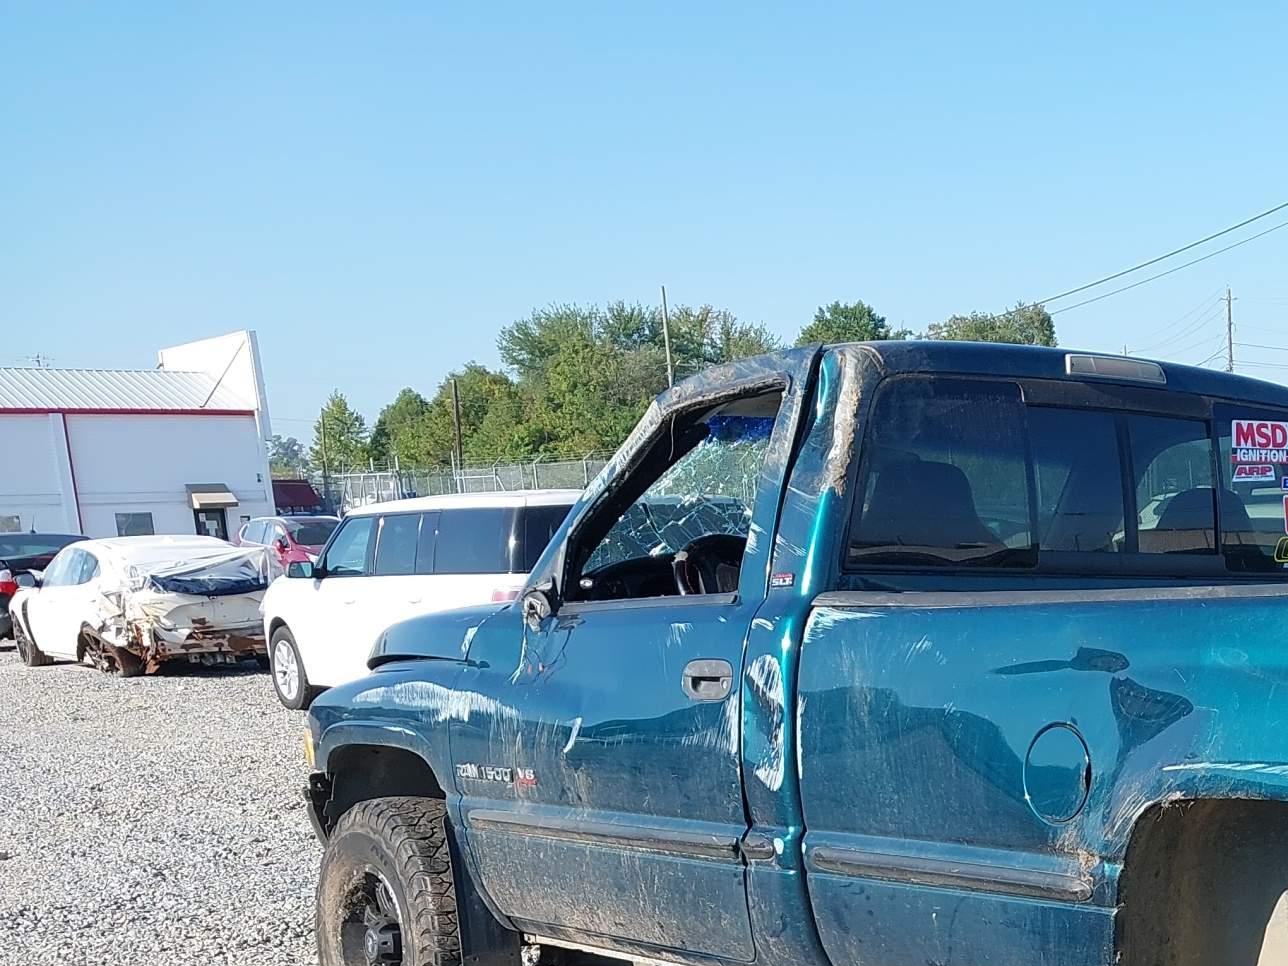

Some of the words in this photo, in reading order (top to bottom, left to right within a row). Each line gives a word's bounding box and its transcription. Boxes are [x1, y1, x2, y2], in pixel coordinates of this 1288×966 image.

[1235, 422, 1288, 449] MSD
[1236, 449, 1287, 463] IGNITION
[1236, 466, 1273, 475] ARP
[481, 766, 512, 781] 1500
